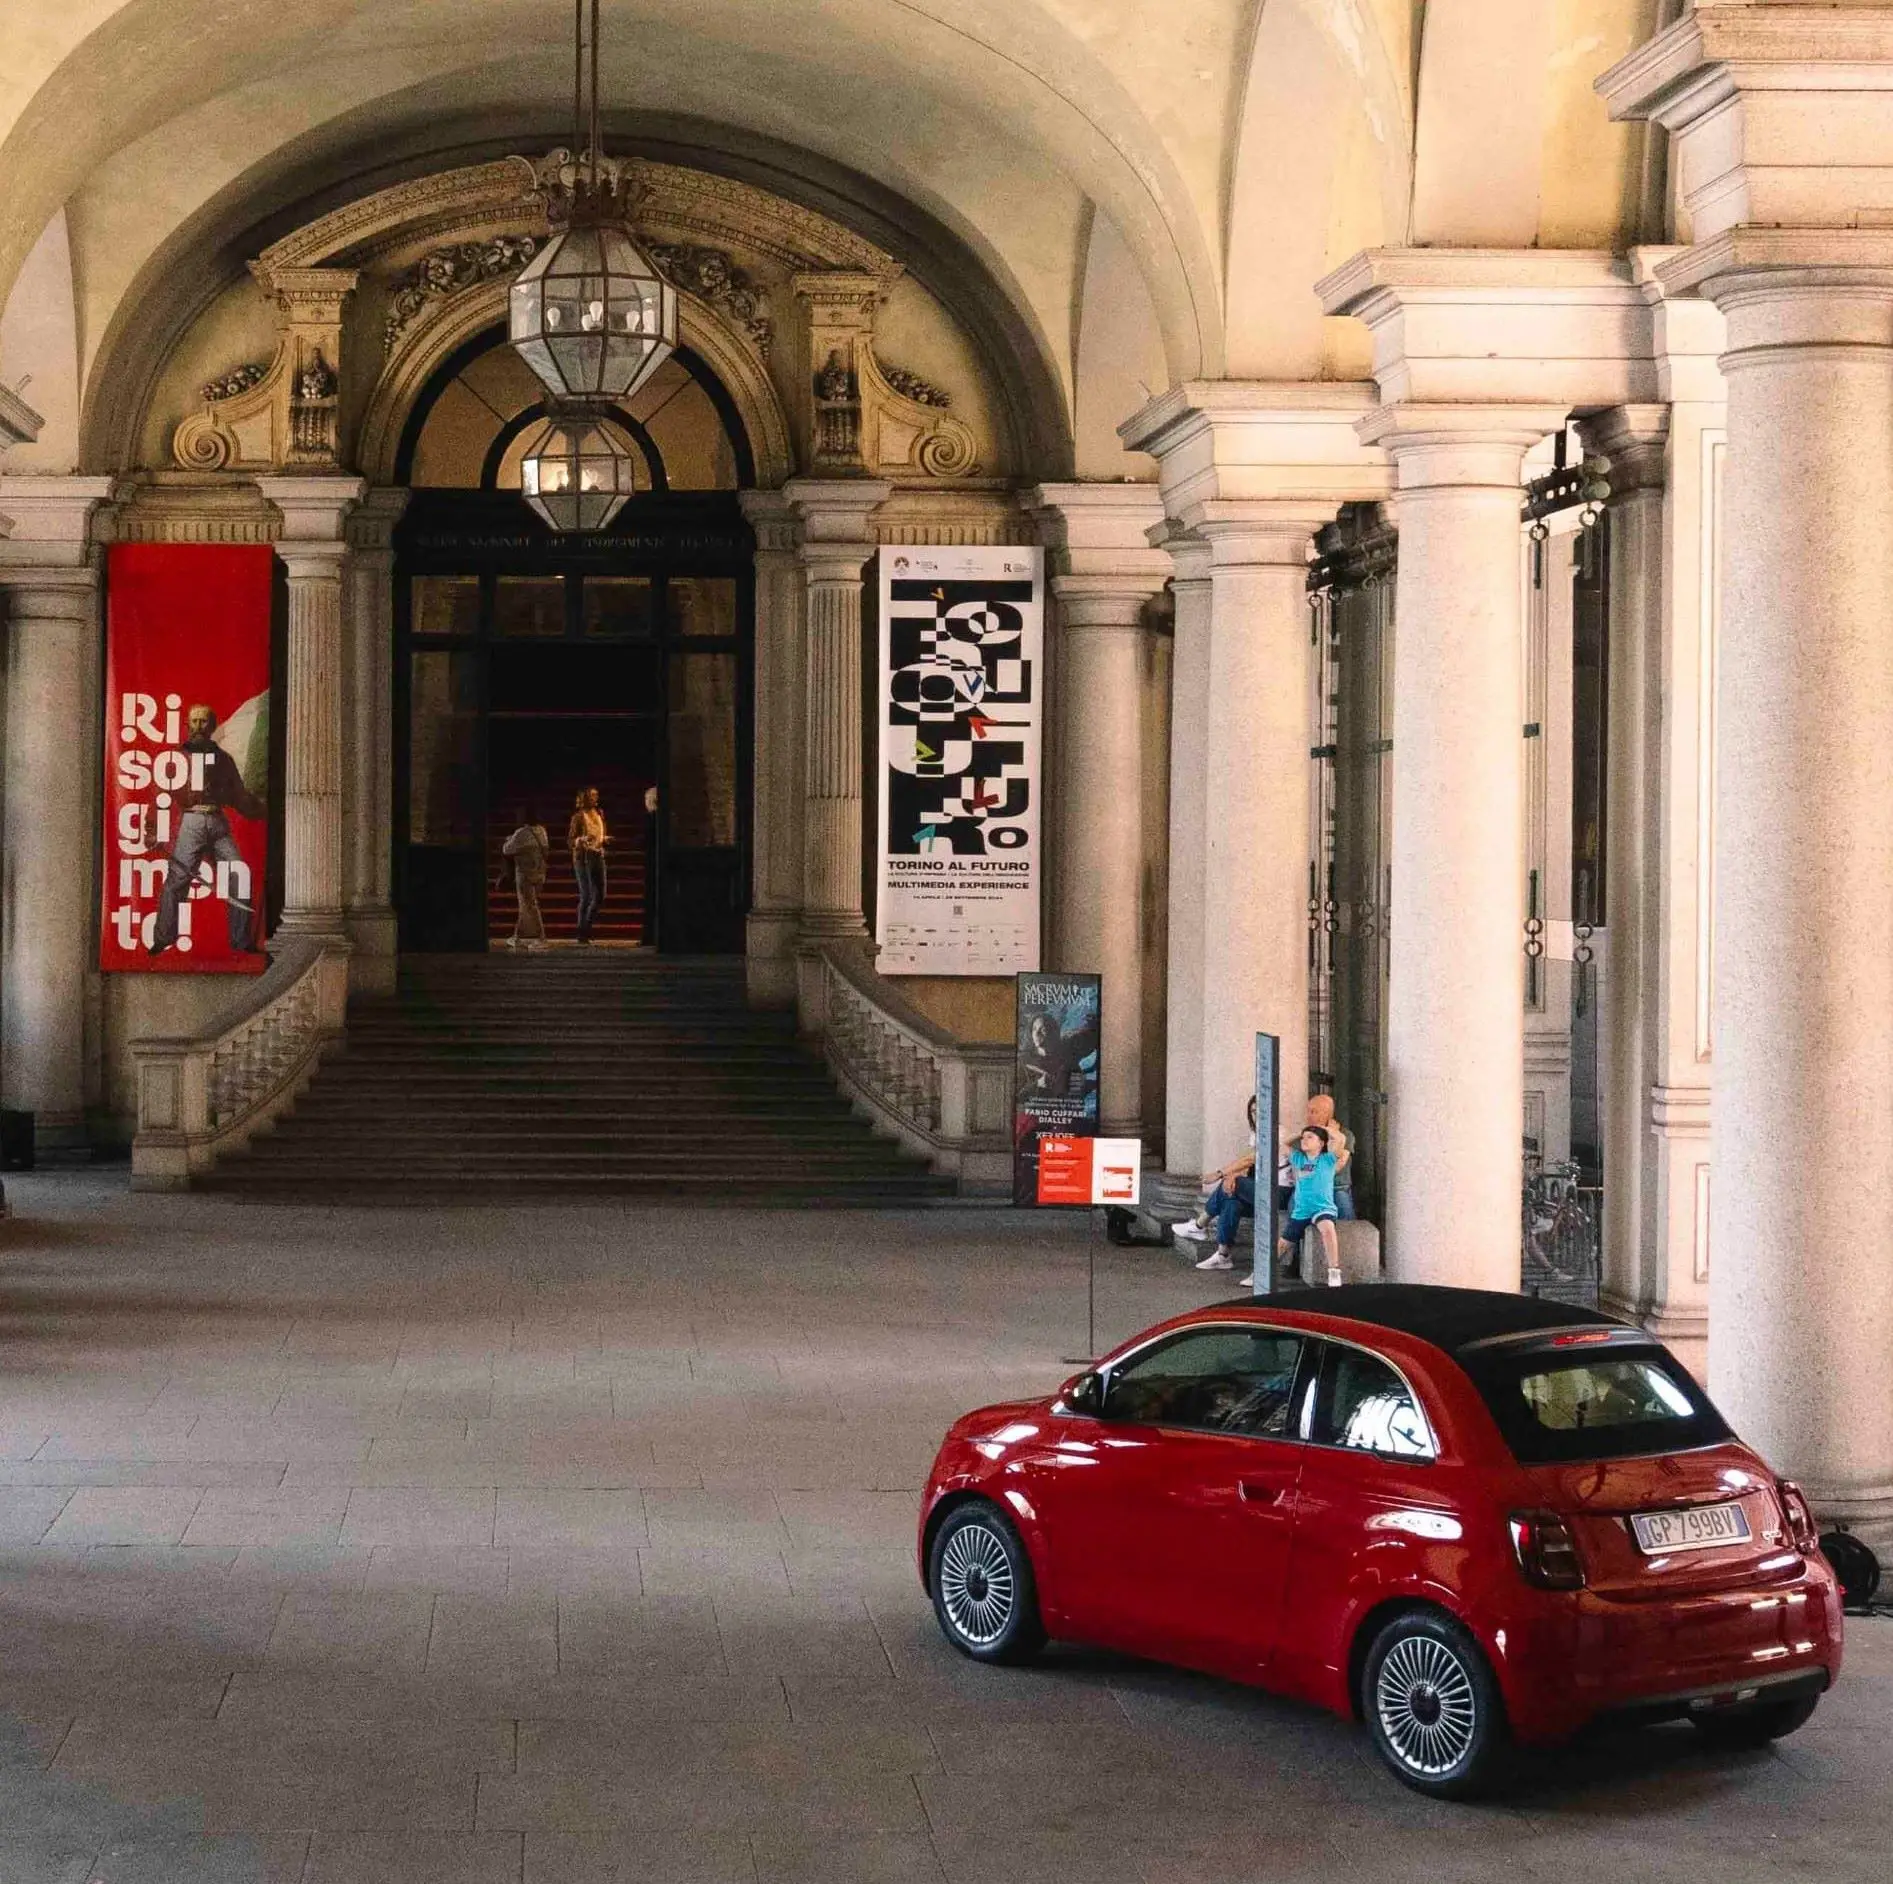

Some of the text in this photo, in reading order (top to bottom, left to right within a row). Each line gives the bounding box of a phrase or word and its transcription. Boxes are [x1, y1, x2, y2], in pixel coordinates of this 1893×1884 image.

[120, 693, 182, 744] Ri
[117, 750, 215, 791] sor
[117, 792, 172, 855] gi
[888, 861, 1030, 871] TORINO AL FUTURO
[888, 881, 1029, 890] MULTIMEDIA EXPERIENCE
[1025, 1108, 1050, 1116] FABIO
[1649, 1508, 1734, 1543] GP 799BV
